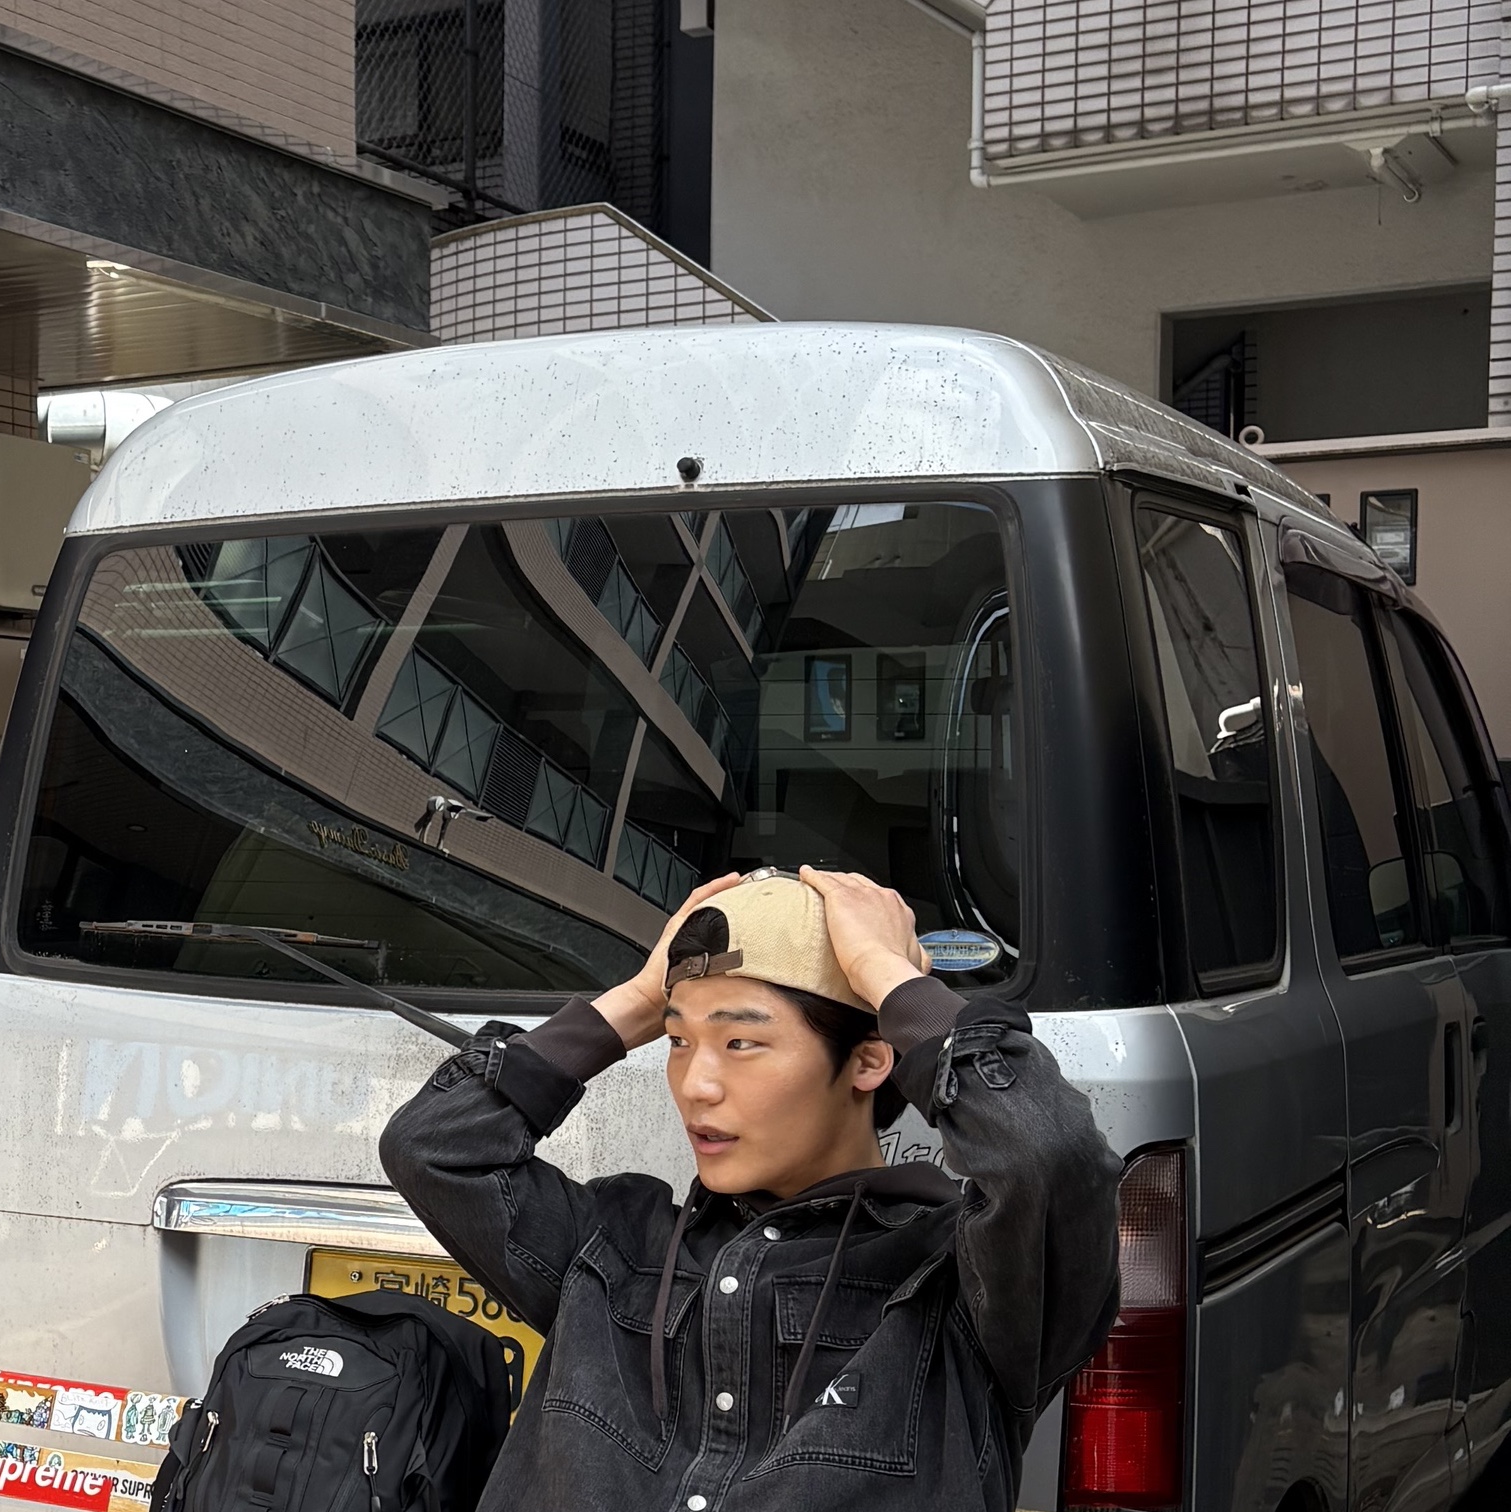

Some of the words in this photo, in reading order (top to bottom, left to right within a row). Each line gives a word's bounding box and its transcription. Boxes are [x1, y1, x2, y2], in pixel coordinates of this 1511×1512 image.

[303, 1346, 328, 1358] THE
[279, 1352, 323, 1366] NORTH
[285, 1361, 319, 1373] FACE
[120, 1479, 153, 1499] SUPR
